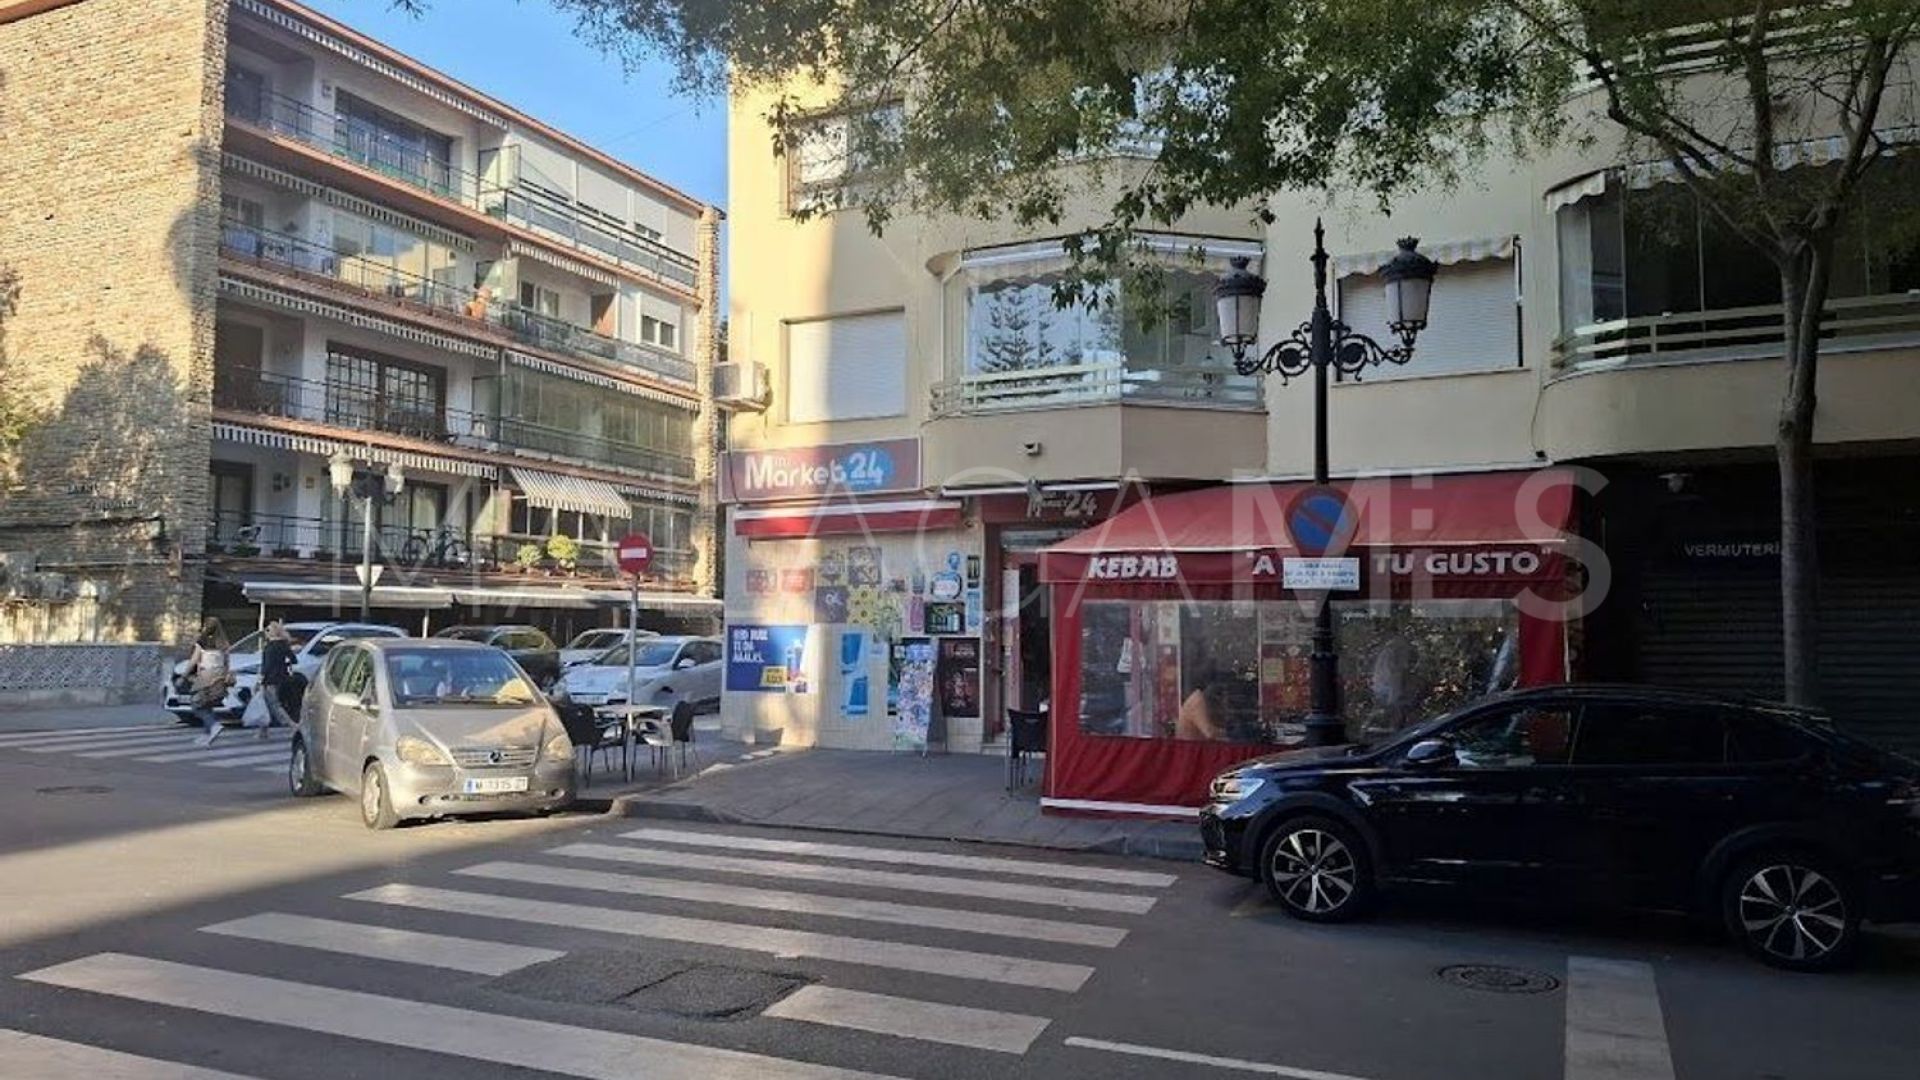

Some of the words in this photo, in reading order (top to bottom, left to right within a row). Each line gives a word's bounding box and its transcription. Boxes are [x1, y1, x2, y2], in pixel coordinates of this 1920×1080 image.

[744, 454, 847, 490] Market
[850, 451, 884, 484] 24
[1064, 491, 1098, 517] 24
[1087, 555, 1178, 579] KEBAB
[1373, 553, 1415, 574] TU
